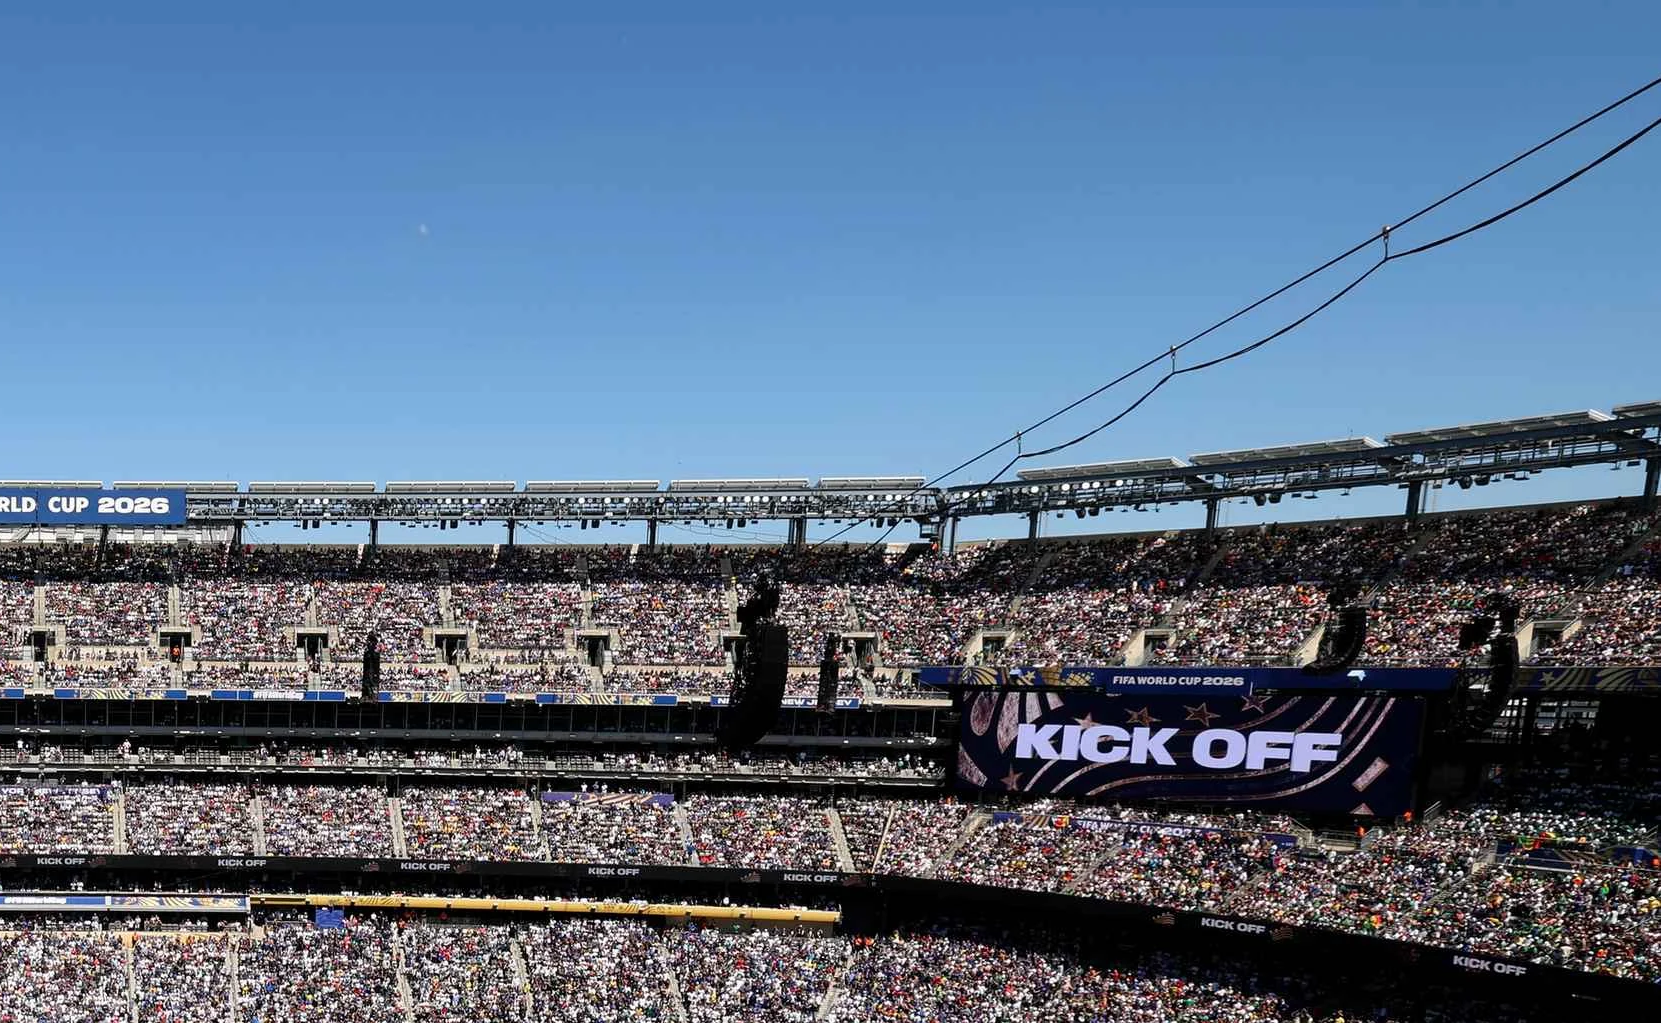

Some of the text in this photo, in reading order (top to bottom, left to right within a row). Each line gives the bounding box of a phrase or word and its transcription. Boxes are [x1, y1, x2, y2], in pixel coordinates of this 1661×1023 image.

[48, 496, 89, 513] CUP
[98, 497, 170, 514] 2026
[1113, 675, 1244, 686] FIFA WORLD CUP 2026
[1016, 723, 1342, 773] KICK OFF
[37, 857, 86, 865] KICK OFF
[218, 859, 267, 868] KICK OFF
[400, 862, 450, 871] KICK OFF
[588, 867, 640, 876] KICK OFF
[784, 873, 838, 883] KICK OFF
[1201, 917, 1266, 934] KICK OFF
[1453, 955, 1527, 977] KICK OFF
